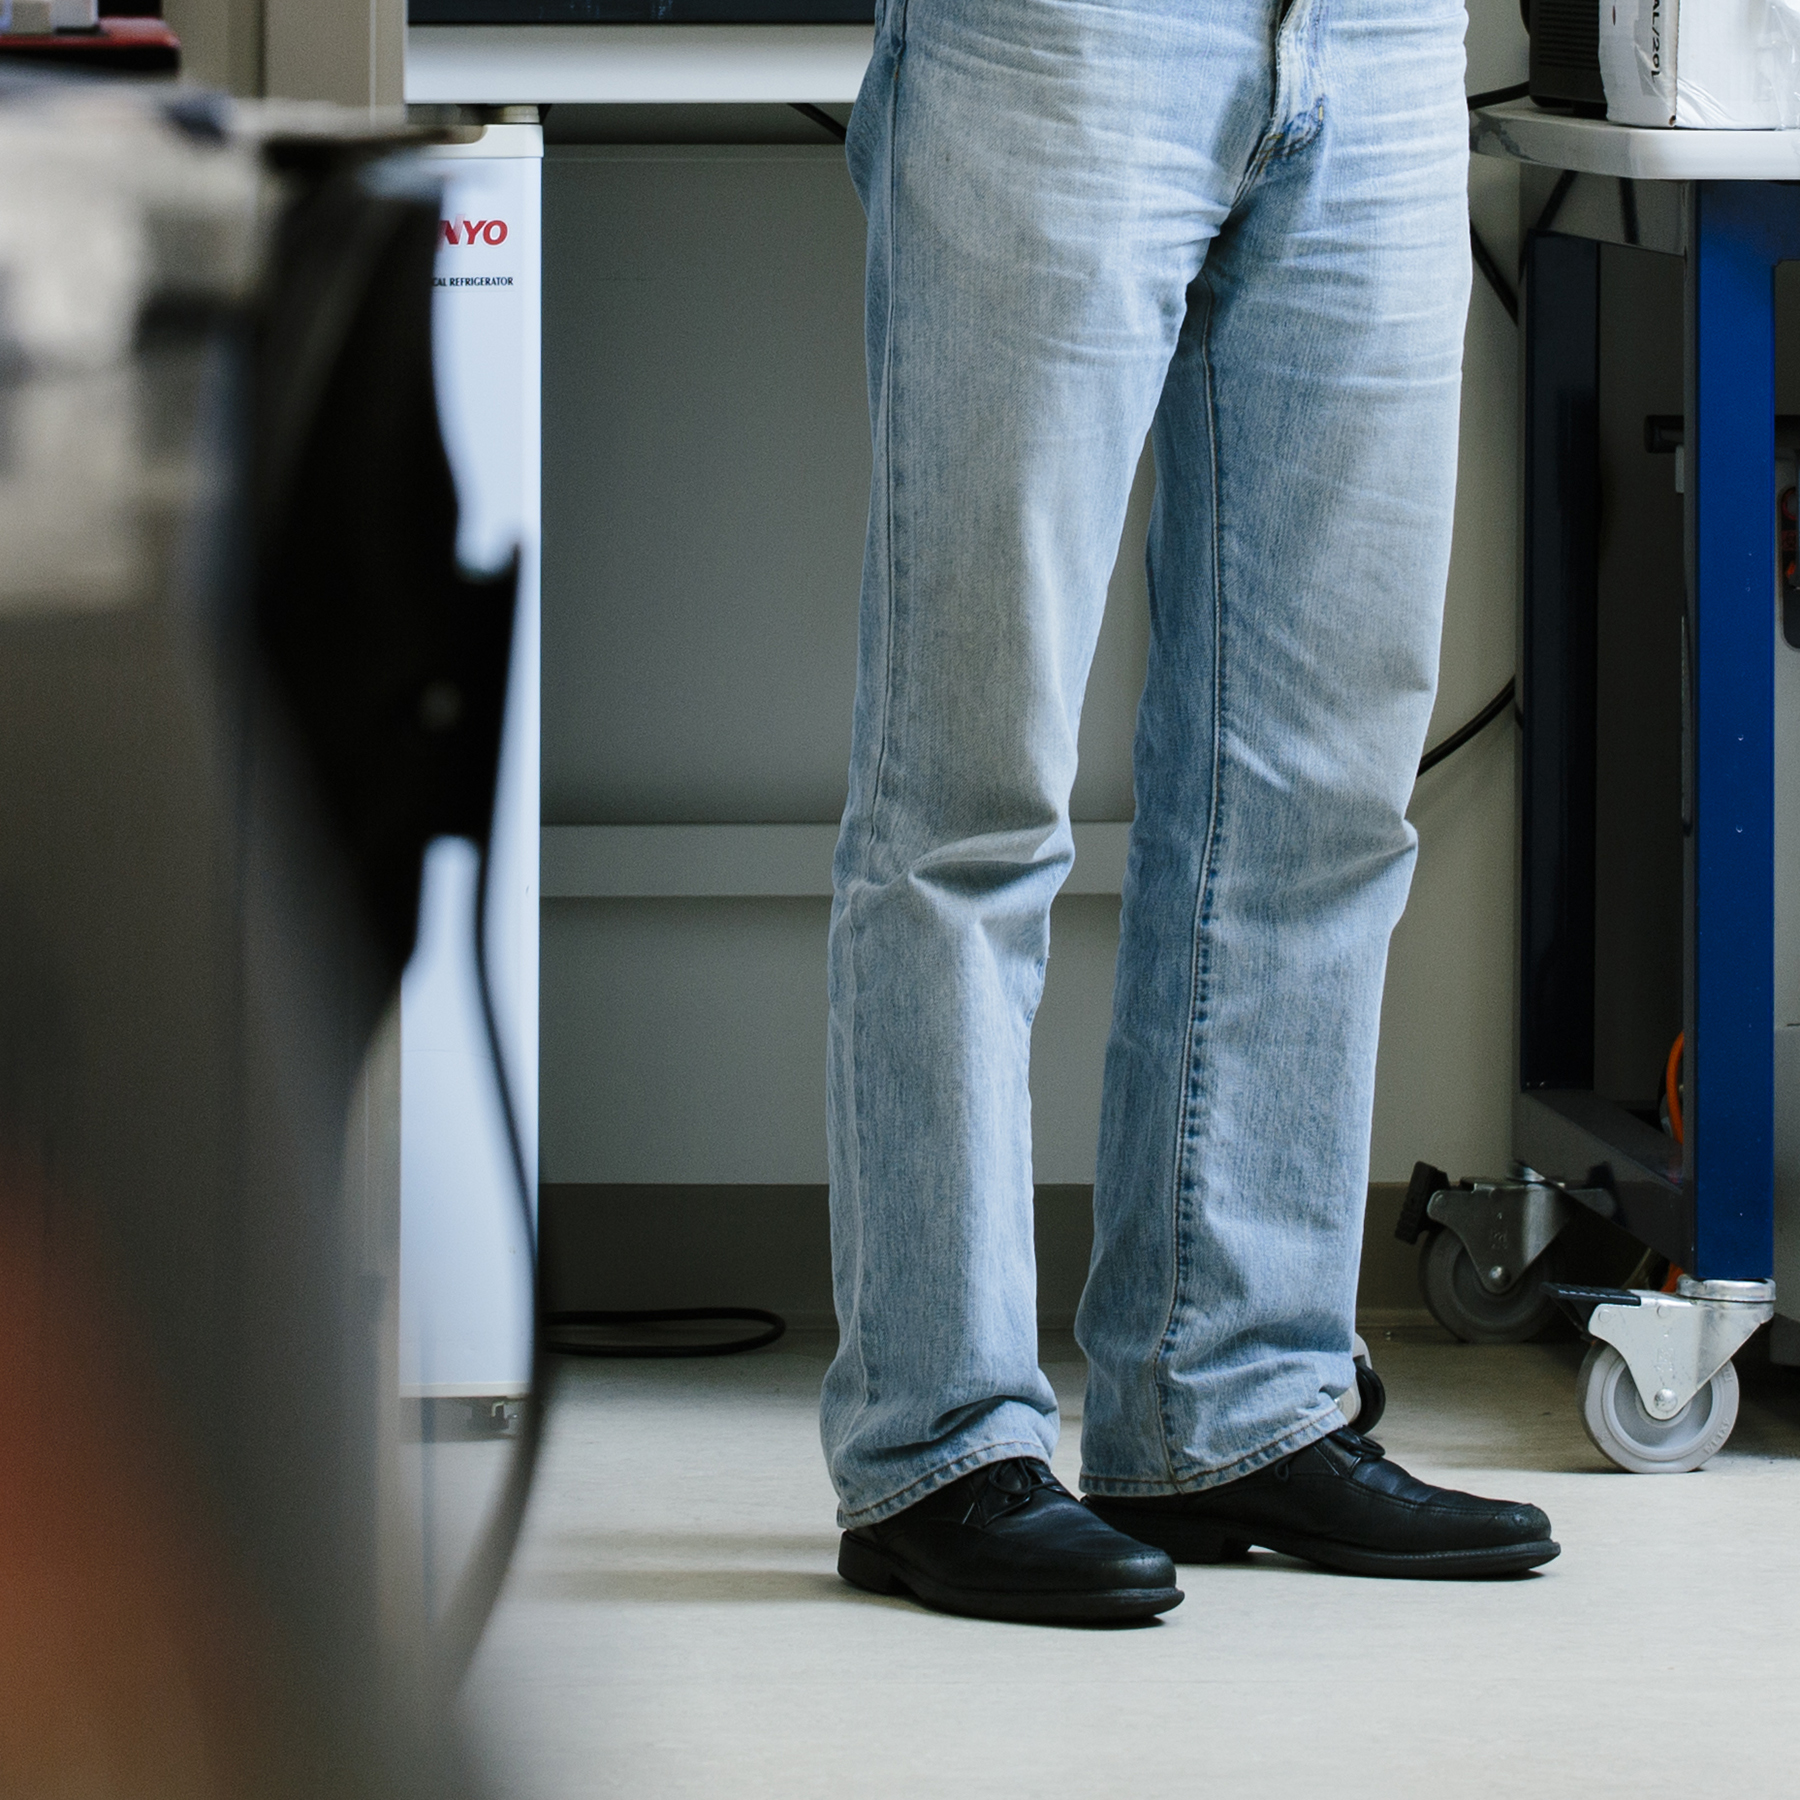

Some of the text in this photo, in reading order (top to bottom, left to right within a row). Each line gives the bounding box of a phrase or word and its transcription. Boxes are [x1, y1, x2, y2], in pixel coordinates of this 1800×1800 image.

[435, 216, 509, 250] NYO
[431, 276, 514, 287] CAL REFRIGERATOR
